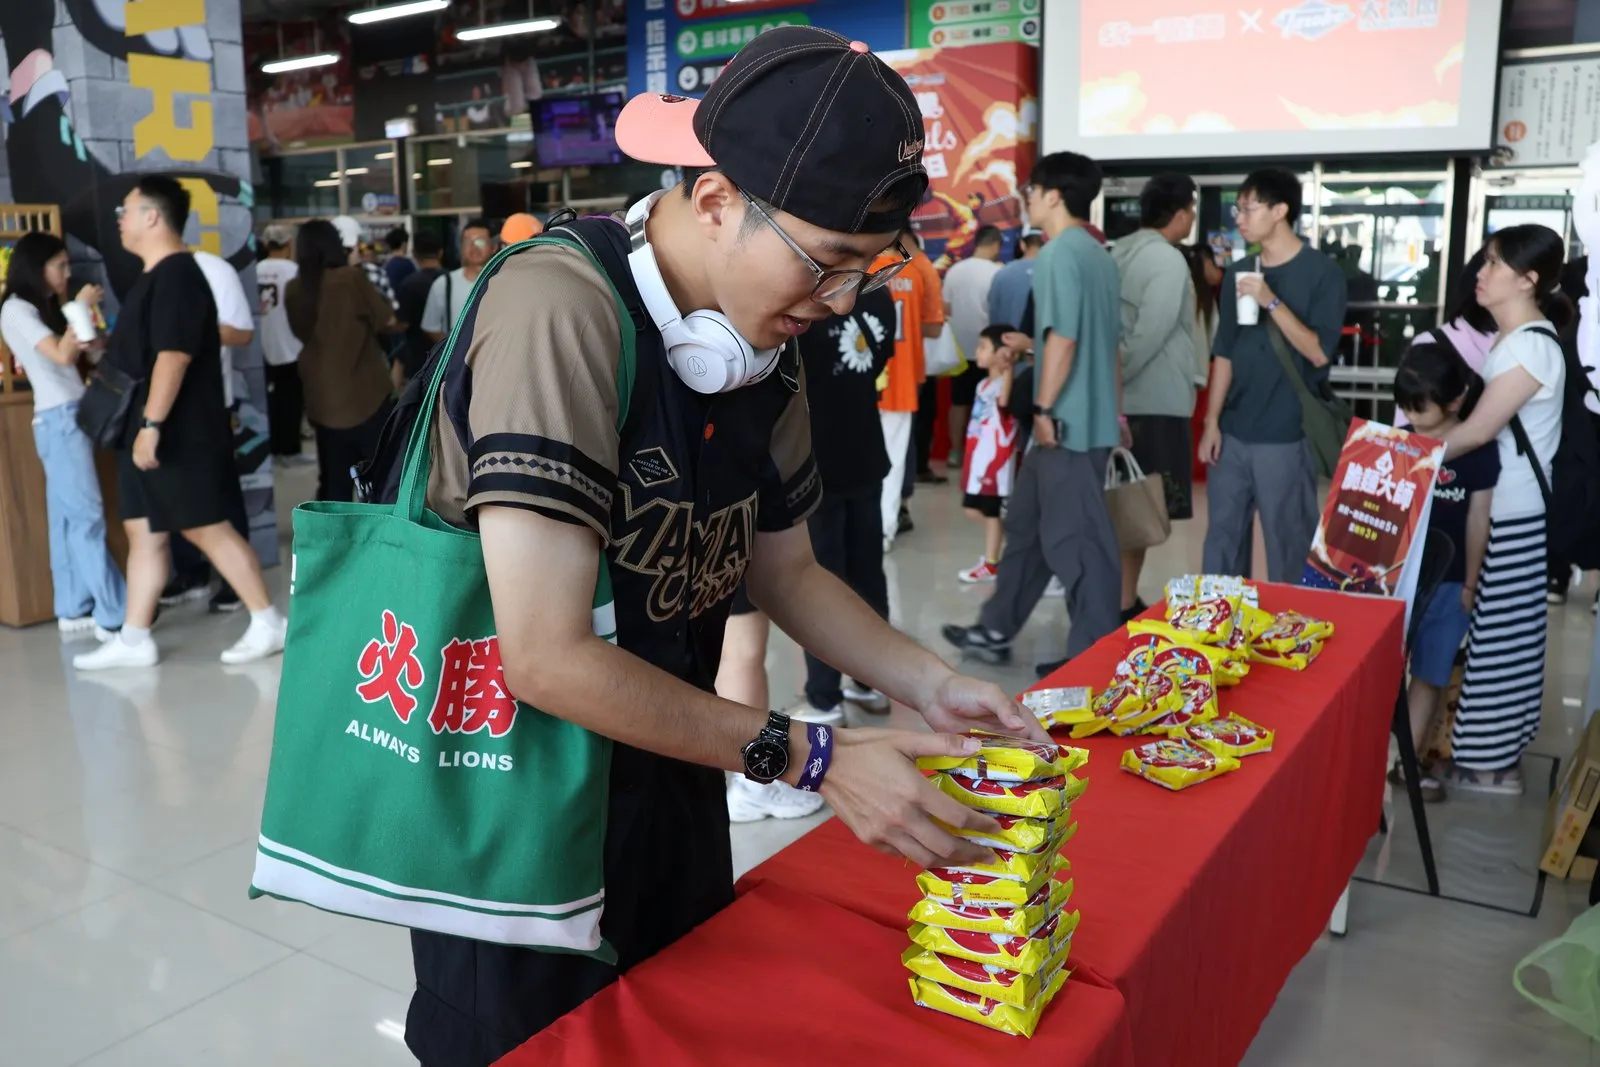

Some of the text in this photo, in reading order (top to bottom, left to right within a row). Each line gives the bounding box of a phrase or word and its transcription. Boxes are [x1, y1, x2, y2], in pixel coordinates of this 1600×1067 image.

[356, 608, 519, 737] 必勝
[345, 719, 514, 772] ALWAYS LIONS
